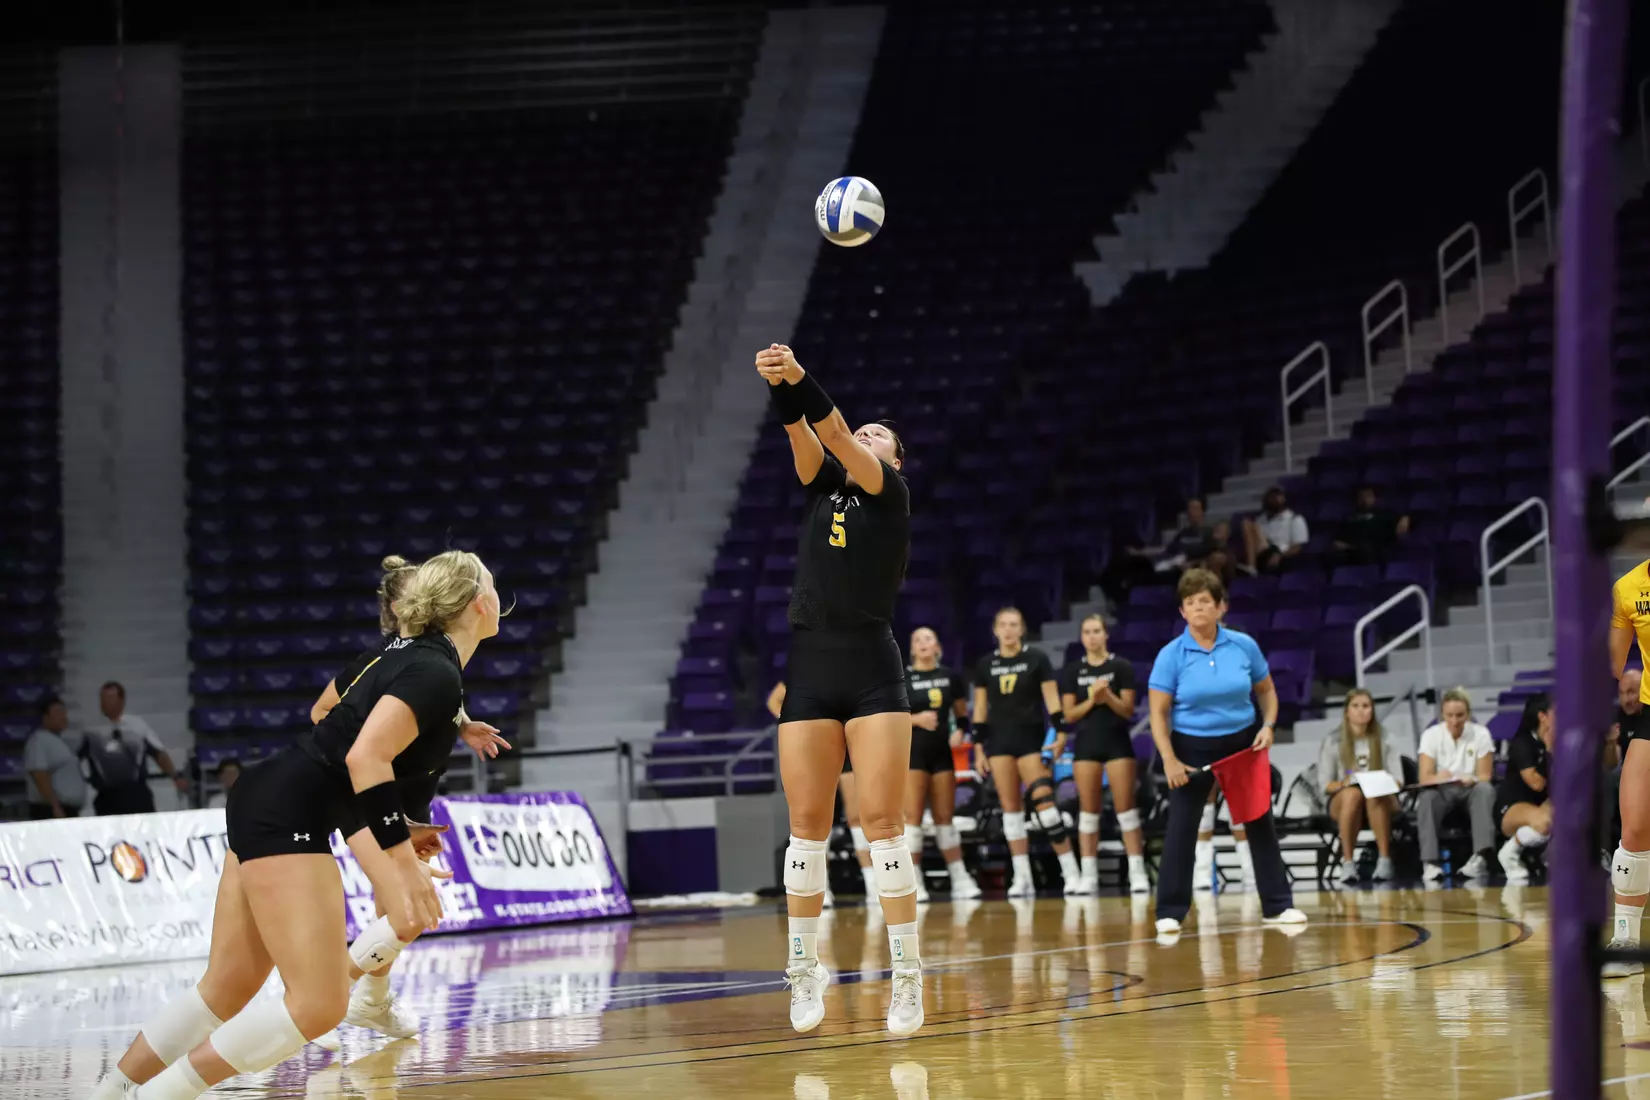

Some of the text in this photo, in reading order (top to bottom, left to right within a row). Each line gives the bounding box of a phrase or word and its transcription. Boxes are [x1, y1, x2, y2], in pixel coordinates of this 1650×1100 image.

[829, 512, 847, 548] 5
[999, 674, 1018, 695] 17
[927, 687, 943, 709] 9
